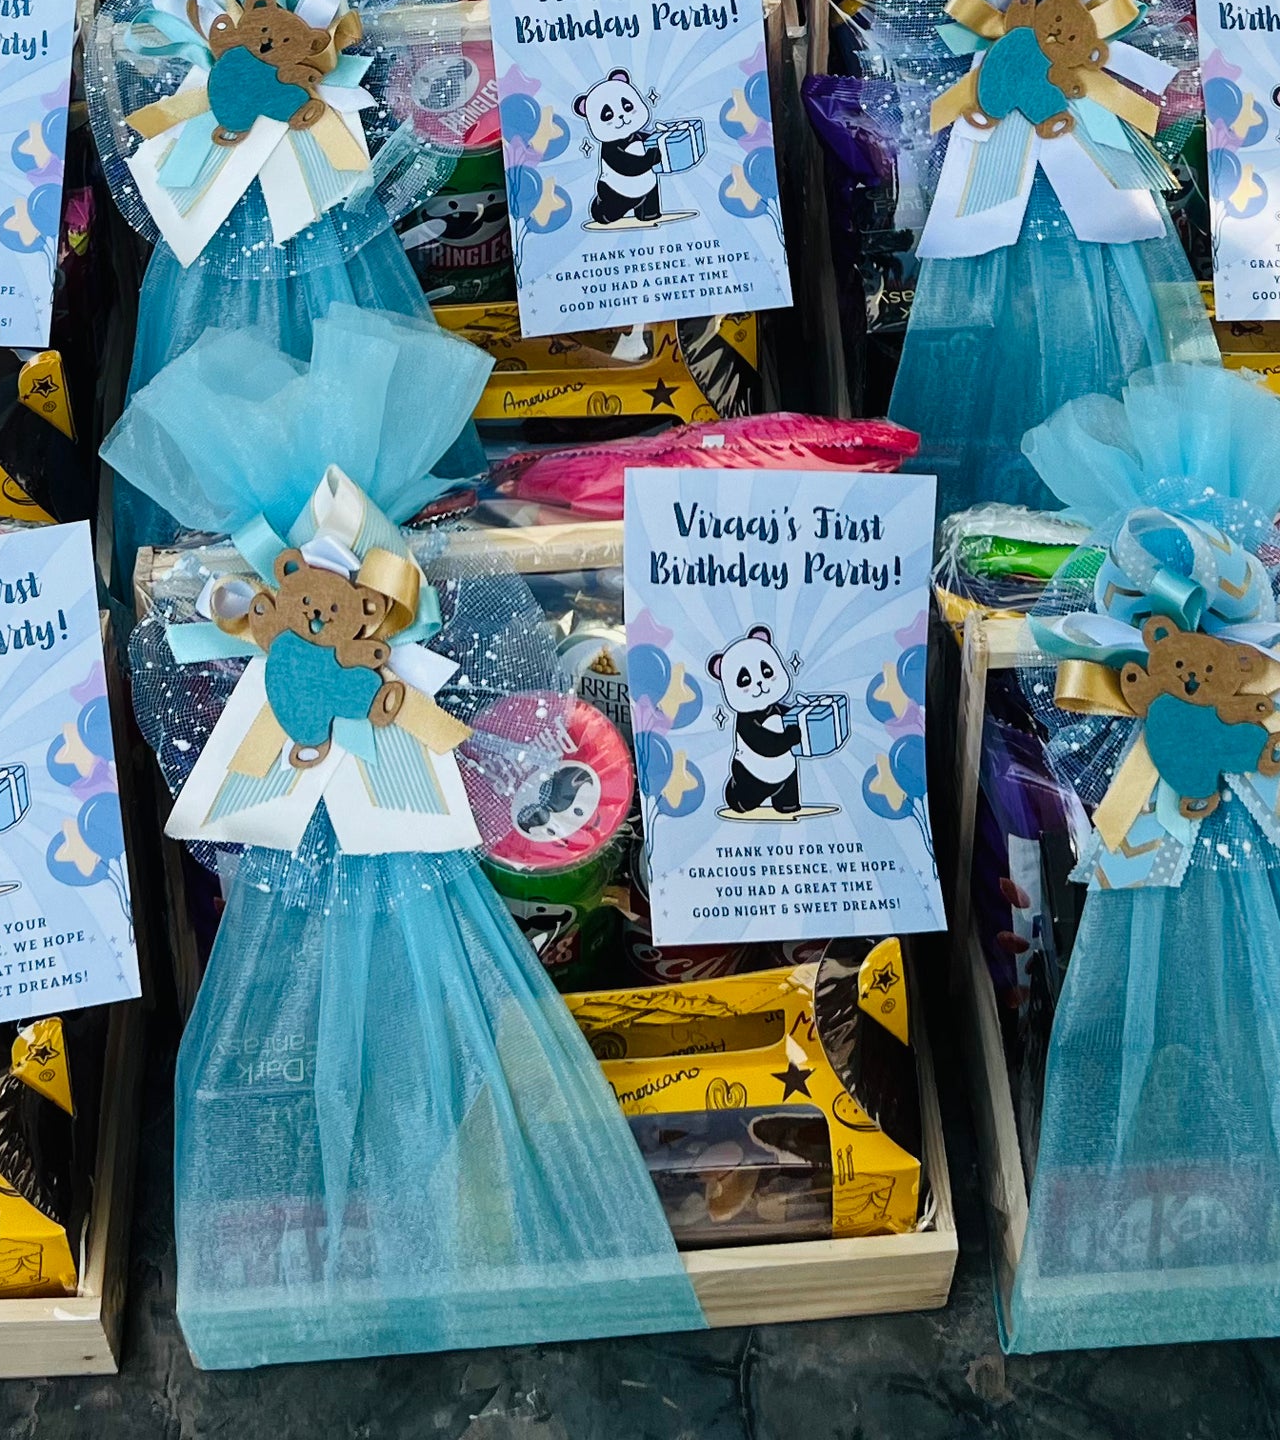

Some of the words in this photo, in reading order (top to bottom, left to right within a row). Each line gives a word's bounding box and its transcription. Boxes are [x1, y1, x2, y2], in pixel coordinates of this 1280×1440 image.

[516, 9, 639, 44] Birthday
[503, 382, 586, 413] Americano
[673, 502, 801, 544] Viraaj's
[813, 506, 884, 543] First
[651, 551, 788, 590] Birthday
[804, 551, 901, 591] Party!
[3, 917, 47, 934] YOUR
[13, 939, 37, 954] WE
[42, 930, 85, 948] HOPE
[18, 955, 57, 972] TIME
[19, 970, 90, 993] DREAMS!
